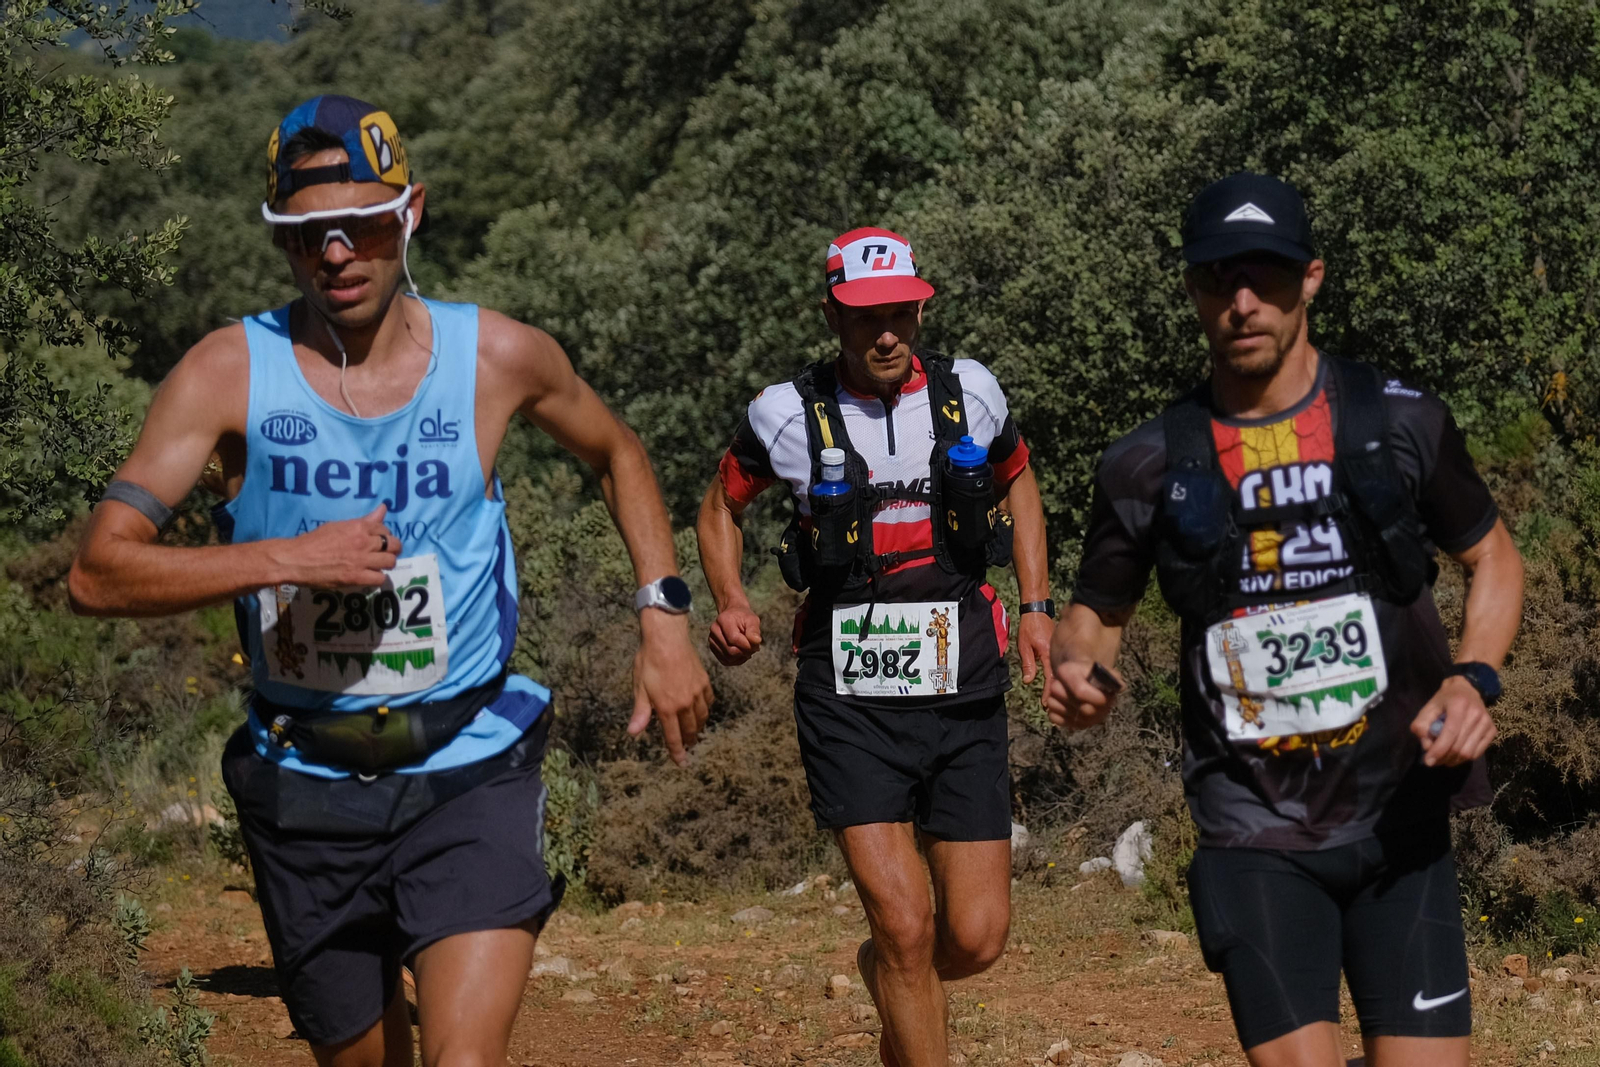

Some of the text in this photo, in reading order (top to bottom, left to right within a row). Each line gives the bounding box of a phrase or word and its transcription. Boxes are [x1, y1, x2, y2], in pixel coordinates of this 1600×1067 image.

[263, 416, 315, 440] TROPS
[418, 408, 459, 442] als
[268, 443, 453, 513] nerja
[313, 587, 432, 632] 2802
[842, 649, 921, 679] 2867
[1261, 620, 1367, 675] 3239
